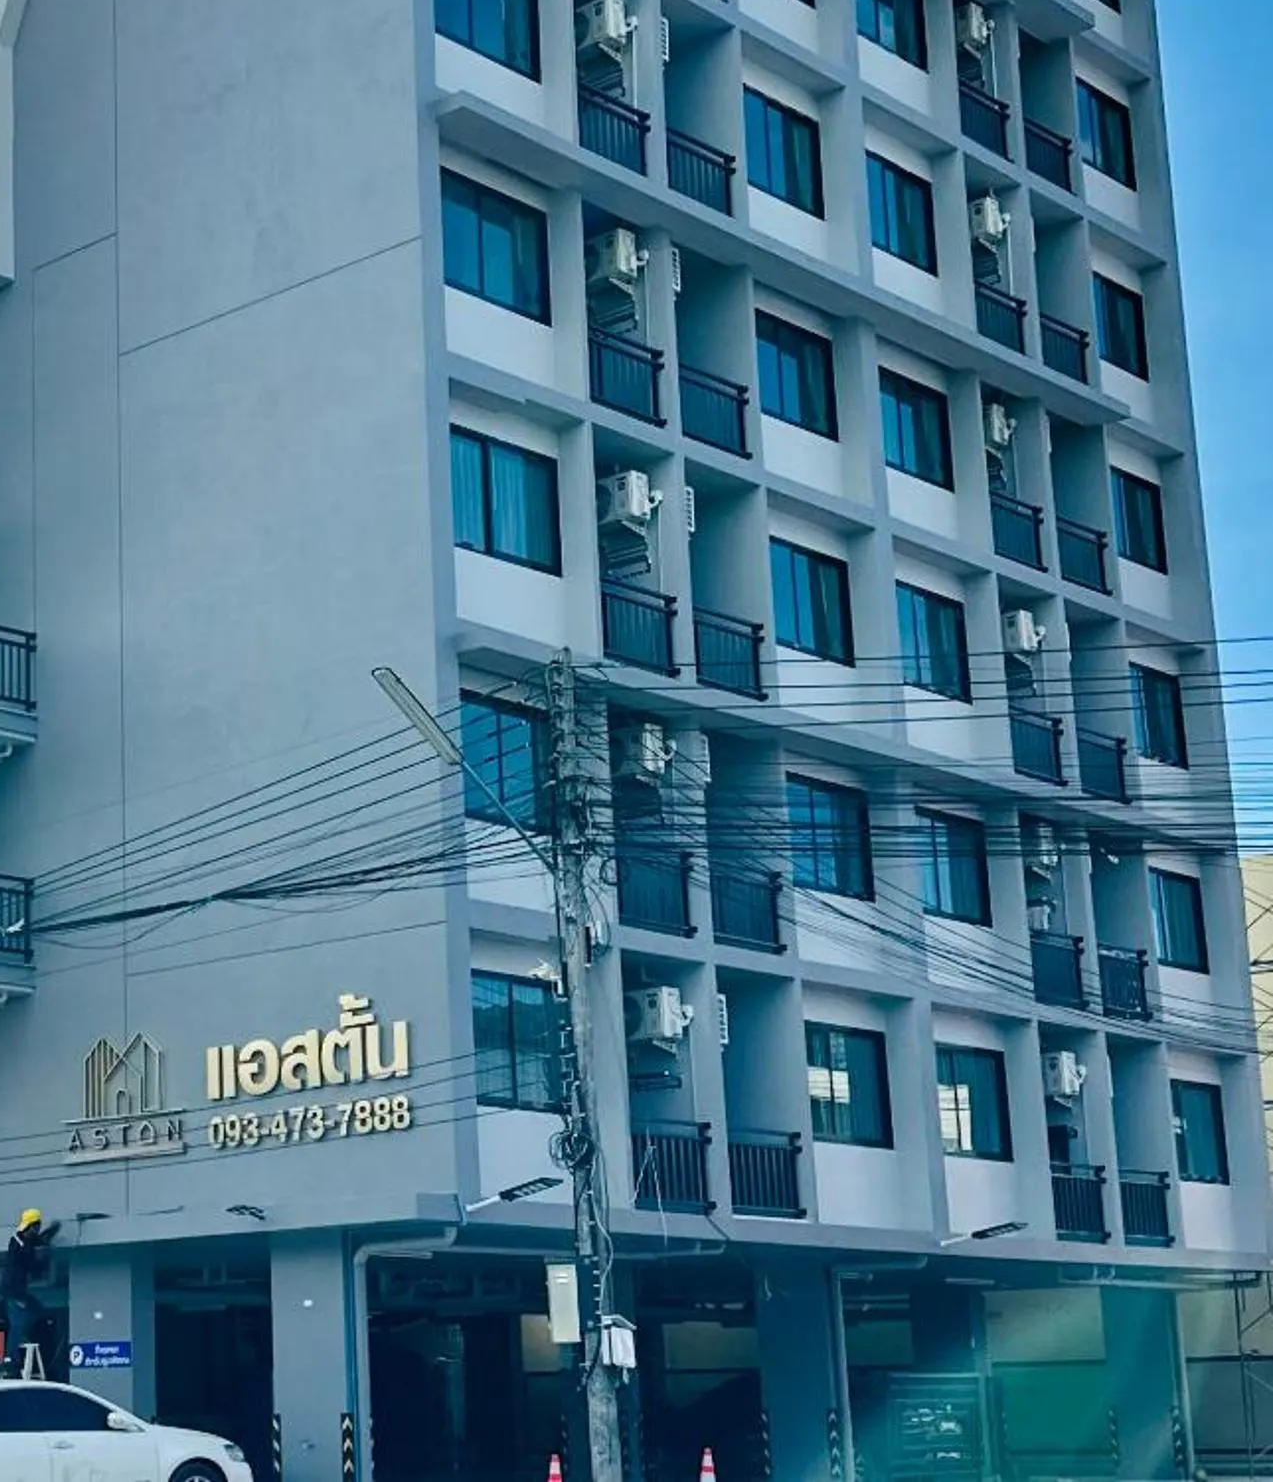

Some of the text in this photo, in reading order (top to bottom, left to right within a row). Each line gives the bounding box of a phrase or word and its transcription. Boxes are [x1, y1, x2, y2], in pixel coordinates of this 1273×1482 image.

[207, 993, 410, 1100] แอสตั้น
[68, 1117, 183, 1152] ASTON
[208, 1095, 412, 1150] 093-473-7888
